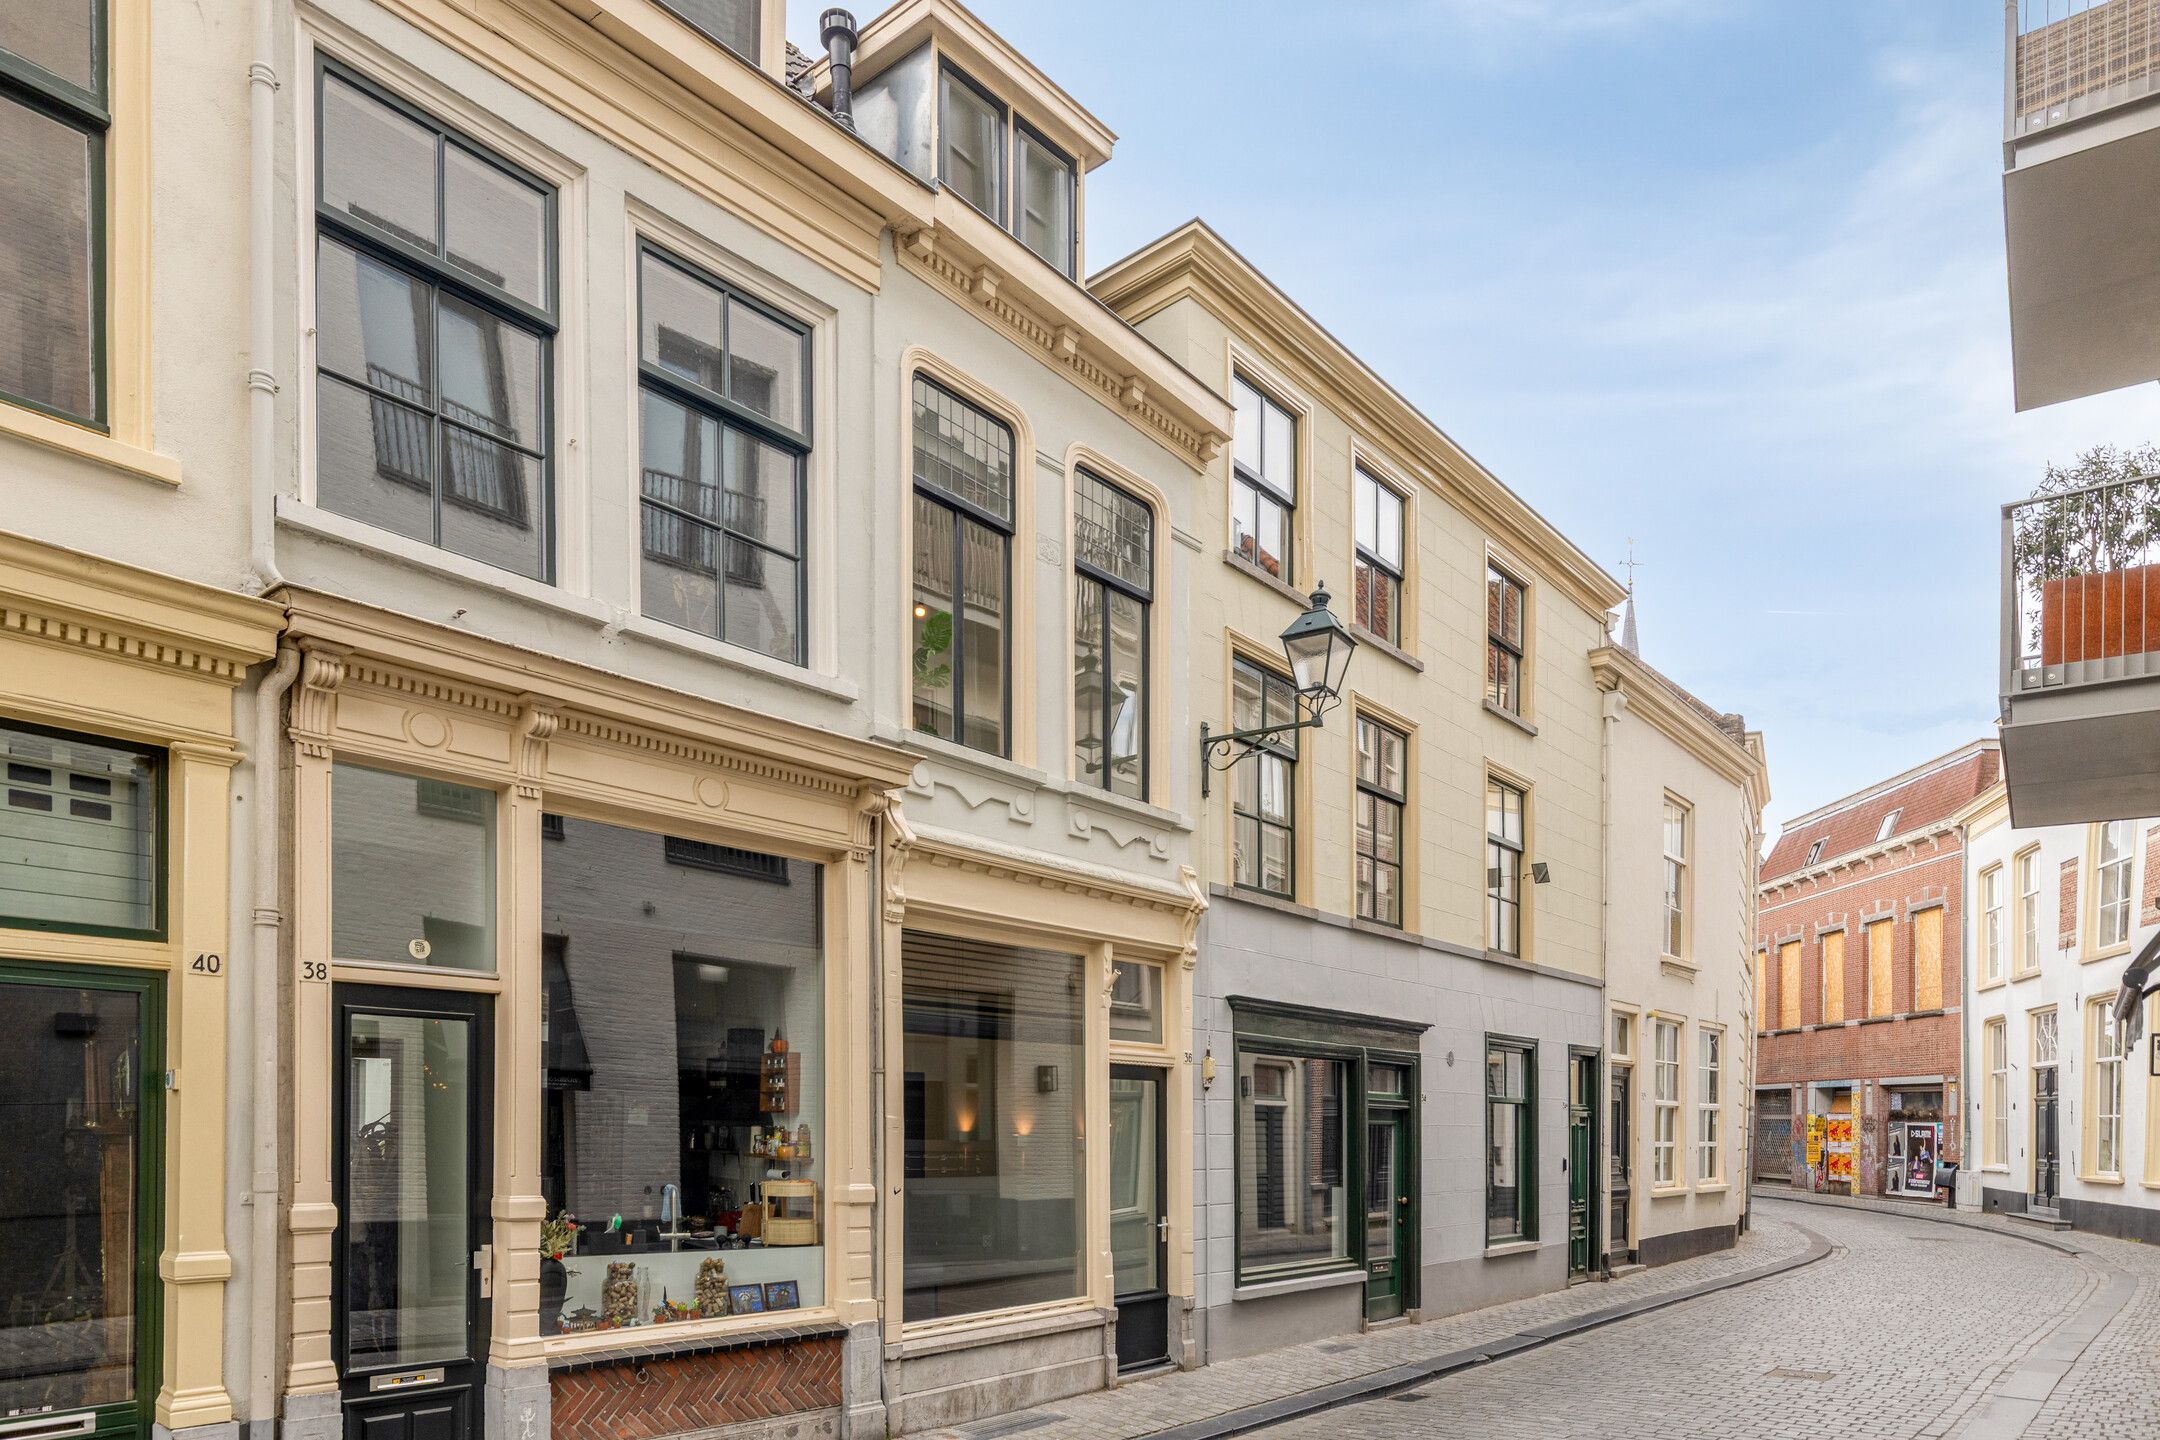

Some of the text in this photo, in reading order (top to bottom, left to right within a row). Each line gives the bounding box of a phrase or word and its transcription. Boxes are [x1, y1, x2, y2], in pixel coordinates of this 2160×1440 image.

[192, 954, 220, 974] 40
[303, 961, 327, 980] 38
[1184, 1052, 1193, 1063] 36
